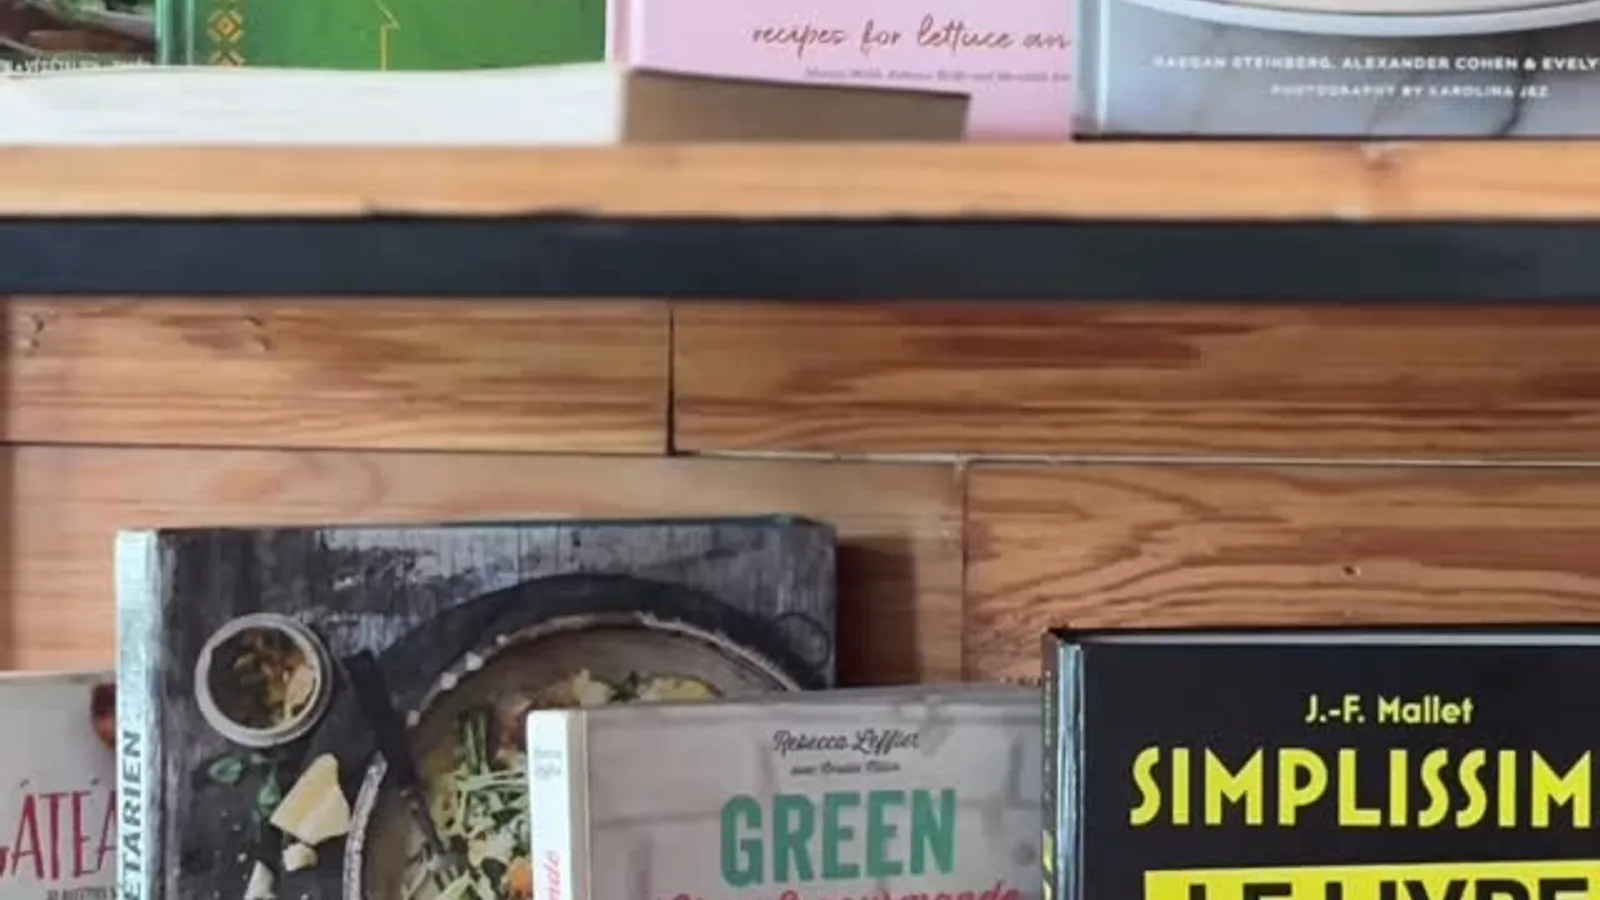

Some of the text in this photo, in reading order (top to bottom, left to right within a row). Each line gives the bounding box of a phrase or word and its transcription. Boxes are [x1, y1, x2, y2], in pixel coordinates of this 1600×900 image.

[751, 22, 848, 57] recipes
[861, 19, 901, 54] for
[917, 13, 1014, 56] lettuce
[1342, 56, 1450, 70] ALEXANDER
[1455, 56, 1518, 71] COHEN
[1523, 56, 1537, 71] &
[1542, 56, 1600, 71] EVELY
[1402, 84, 1423, 98] BY
[1305, 696, 1474, 724] J.-F. Mallet
[773, 730, 848, 759] Rebecca
[1130, 746, 1592, 828] SIMPLISSIM
[720, 788, 956, 888] GREEN
